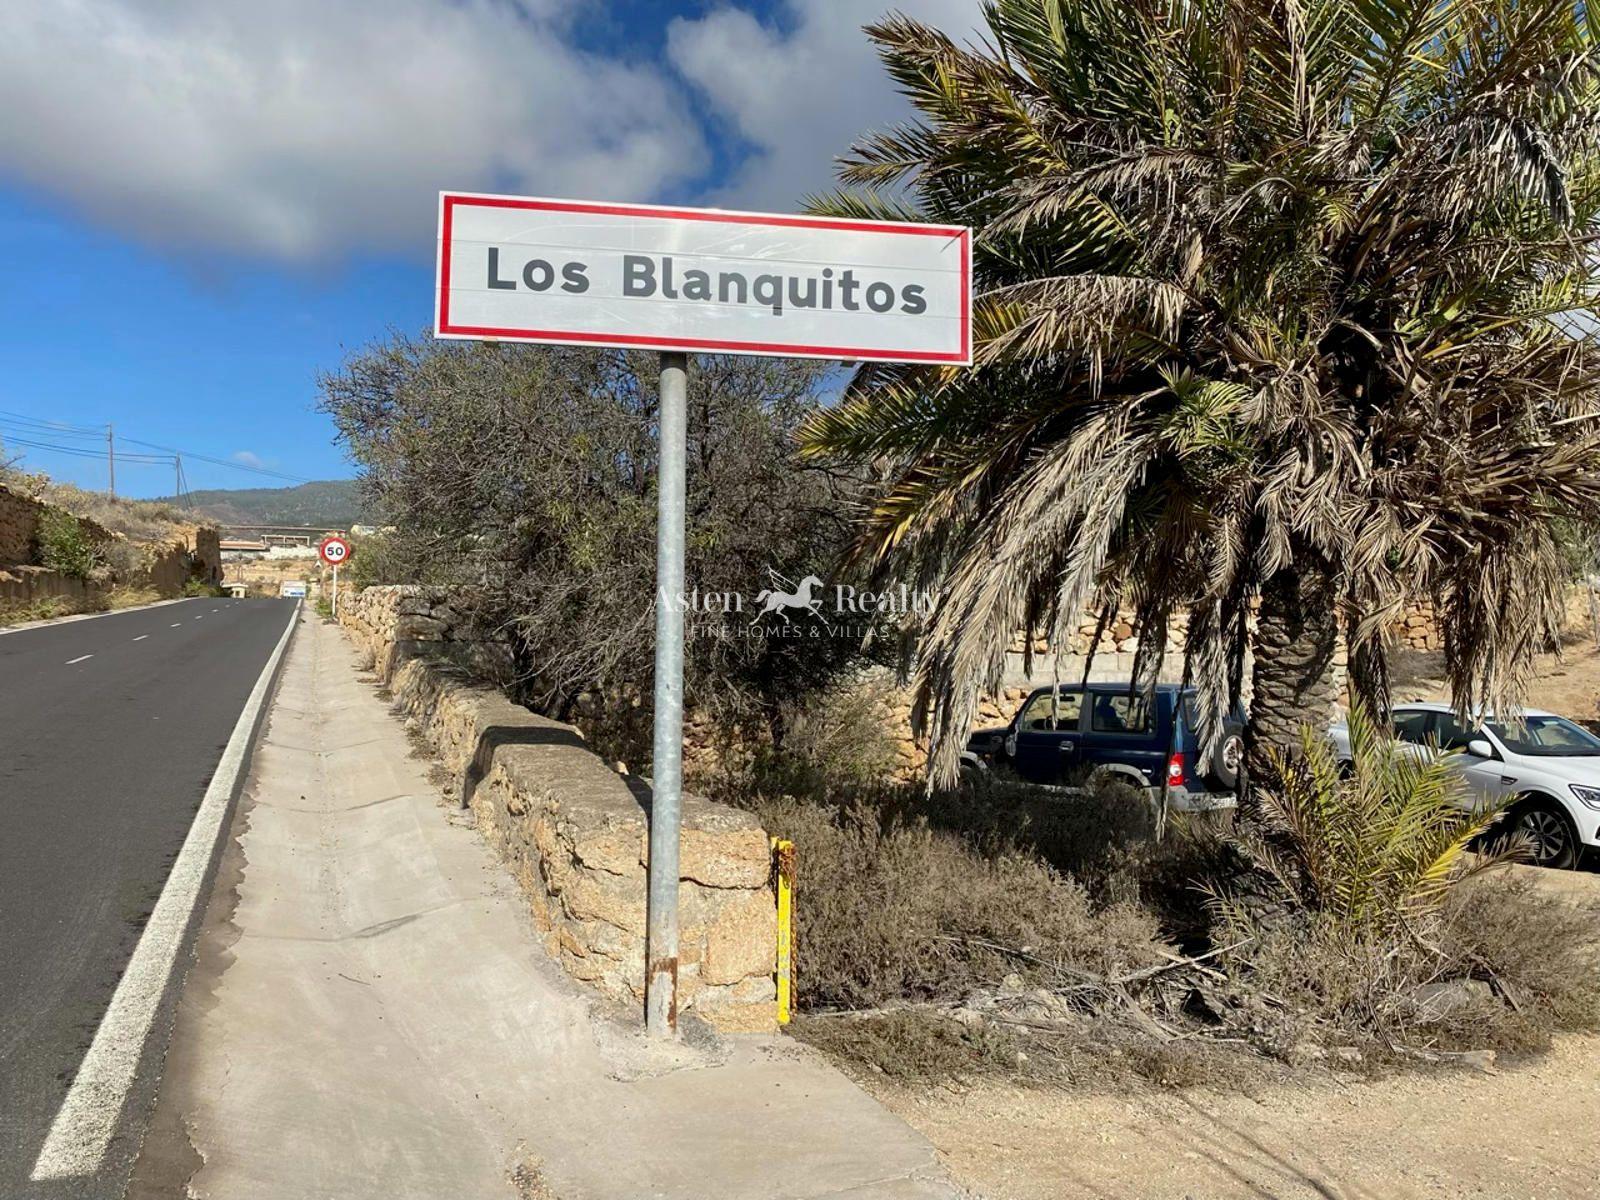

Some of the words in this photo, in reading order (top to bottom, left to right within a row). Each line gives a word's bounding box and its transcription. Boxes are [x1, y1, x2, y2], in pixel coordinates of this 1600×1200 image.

[486, 247, 589, 294] Los
[622, 254, 927, 316] Blanquitos
[327, 547, 343, 556] 50
